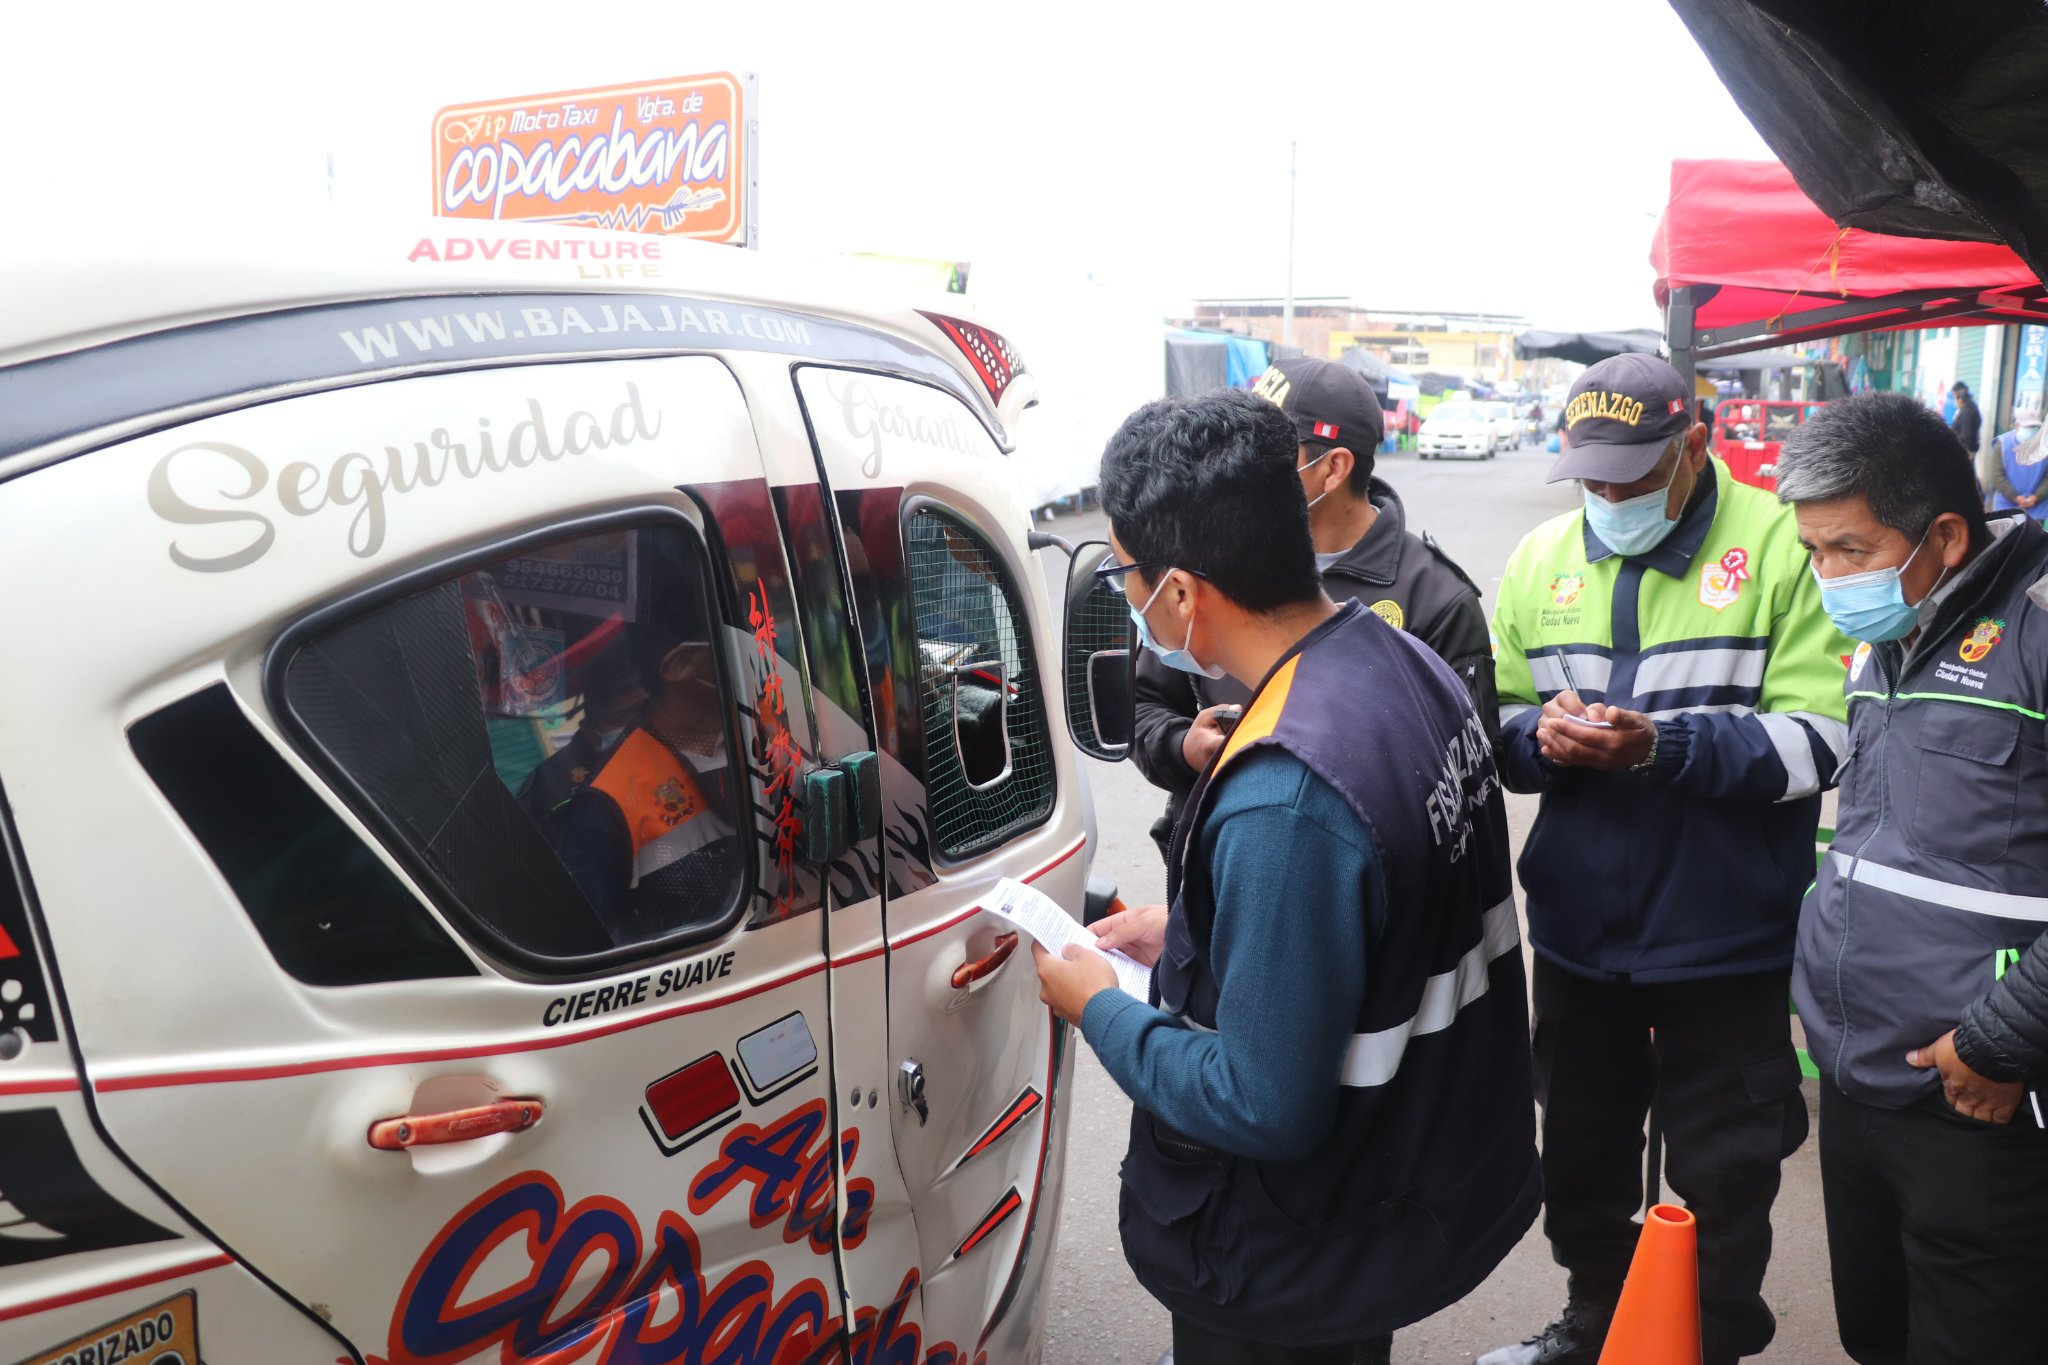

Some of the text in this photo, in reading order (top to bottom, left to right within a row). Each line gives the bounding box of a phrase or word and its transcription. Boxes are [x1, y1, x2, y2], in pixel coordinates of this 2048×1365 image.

[637, 95, 676, 124] Vgta.
[681, 91, 704, 114] de
[445, 105, 729, 219] copacabana
[407, 237, 662, 263] ADVENTURE
[576, 263, 663, 280] LIFE
[339, 304, 813, 364] WWW.BAJAJAR.COM
[1566, 391, 1644, 431] SERENAZGO
[147, 381, 662, 573] Seguridad
[502, 574, 622, 599] 917377604
[507, 560, 623, 585] 954663050
[1935, 669, 1984, 690] Ciudad Nueva
[542, 951, 735, 1028] CIERRE SUAVE
